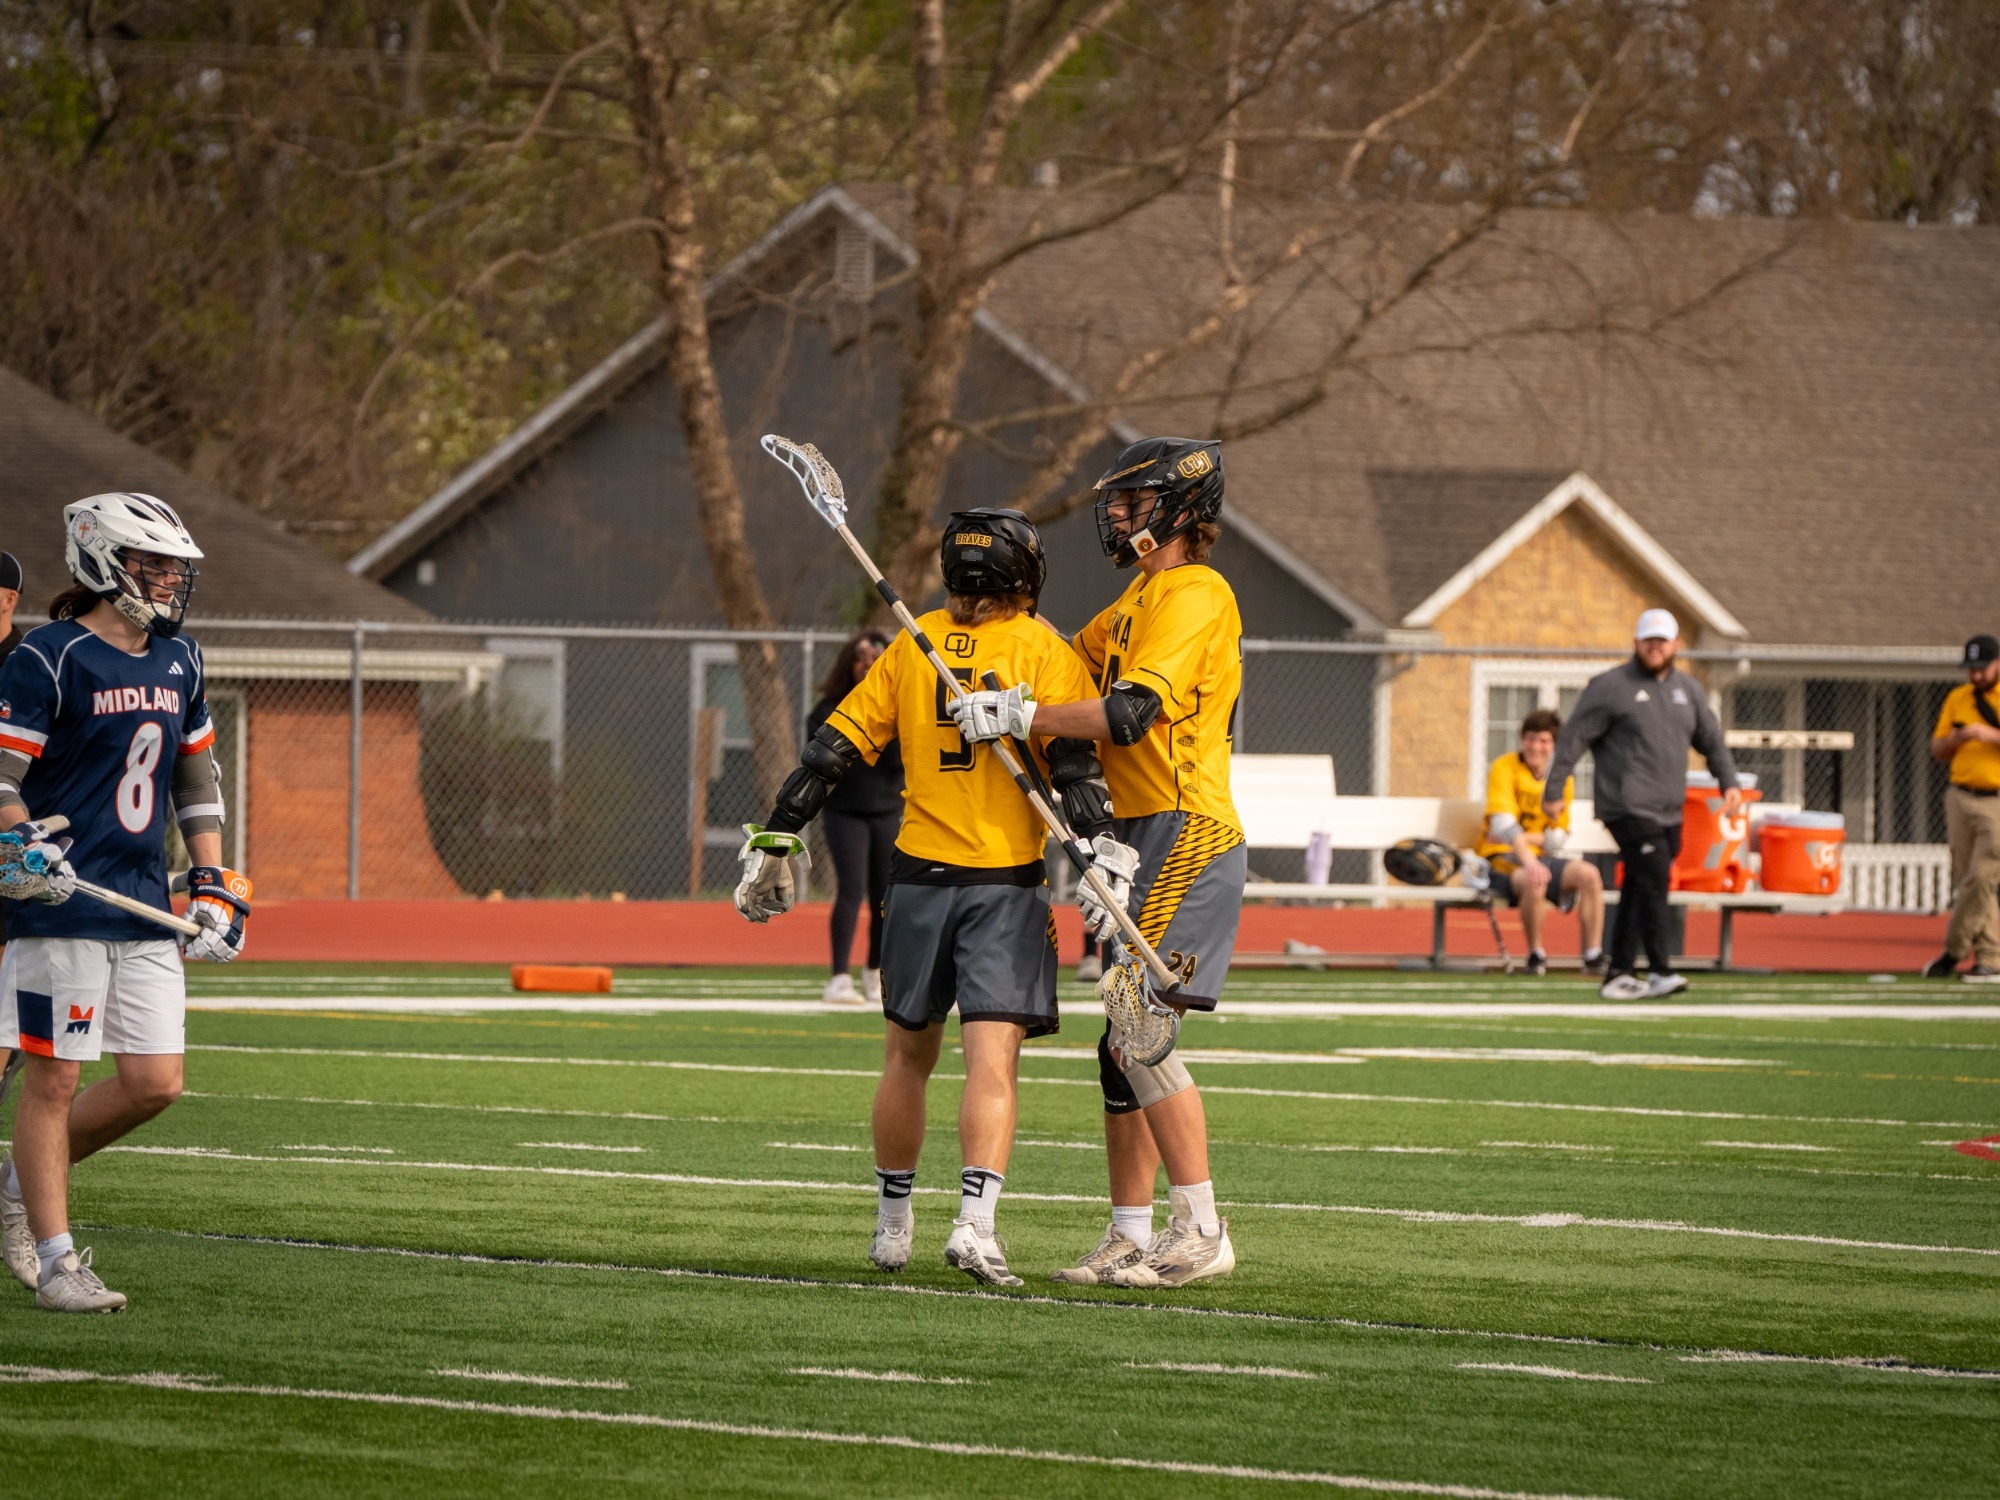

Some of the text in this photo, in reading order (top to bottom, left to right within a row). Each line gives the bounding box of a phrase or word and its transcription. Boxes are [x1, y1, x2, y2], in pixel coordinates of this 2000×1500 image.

[956, 533, 993, 547] BRAVES
[944, 632, 978, 658] OU
[93, 686, 180, 716] MIDLAND
[116, 721, 163, 834] 8
[1166, 950, 1198, 987] 24
